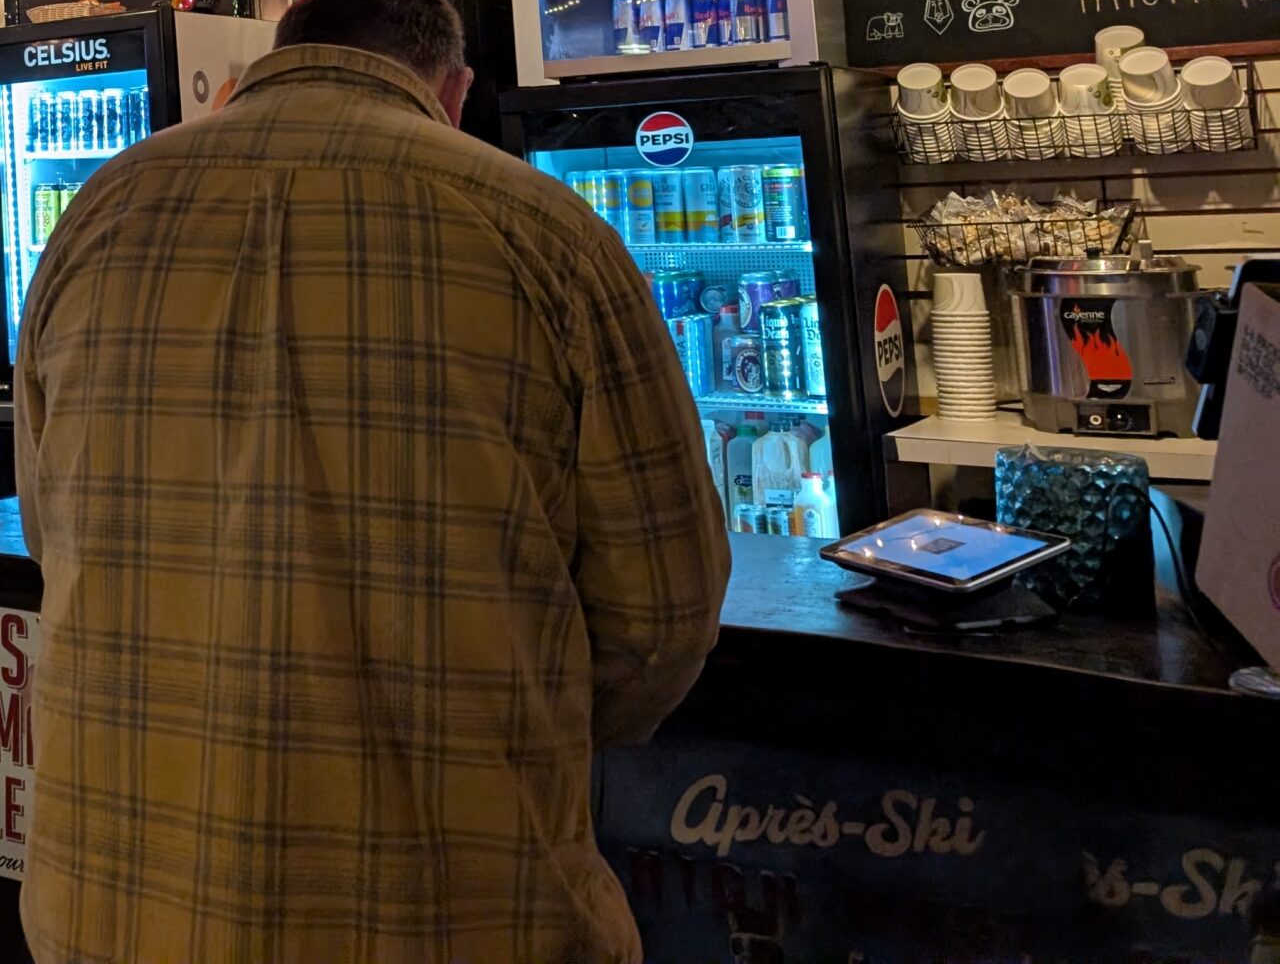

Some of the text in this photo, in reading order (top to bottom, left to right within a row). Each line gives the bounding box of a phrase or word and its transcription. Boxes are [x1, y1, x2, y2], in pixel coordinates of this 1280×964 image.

[23, 38, 108, 68] CELSIUS
[75, 60, 108, 72] LIVE FIT
[639, 132, 690, 147] PEPSI
[1063, 311, 1105, 322] cayenne
[877, 333, 903, 368] PEPSI
[670, 773, 985, 857] Après-Ski
